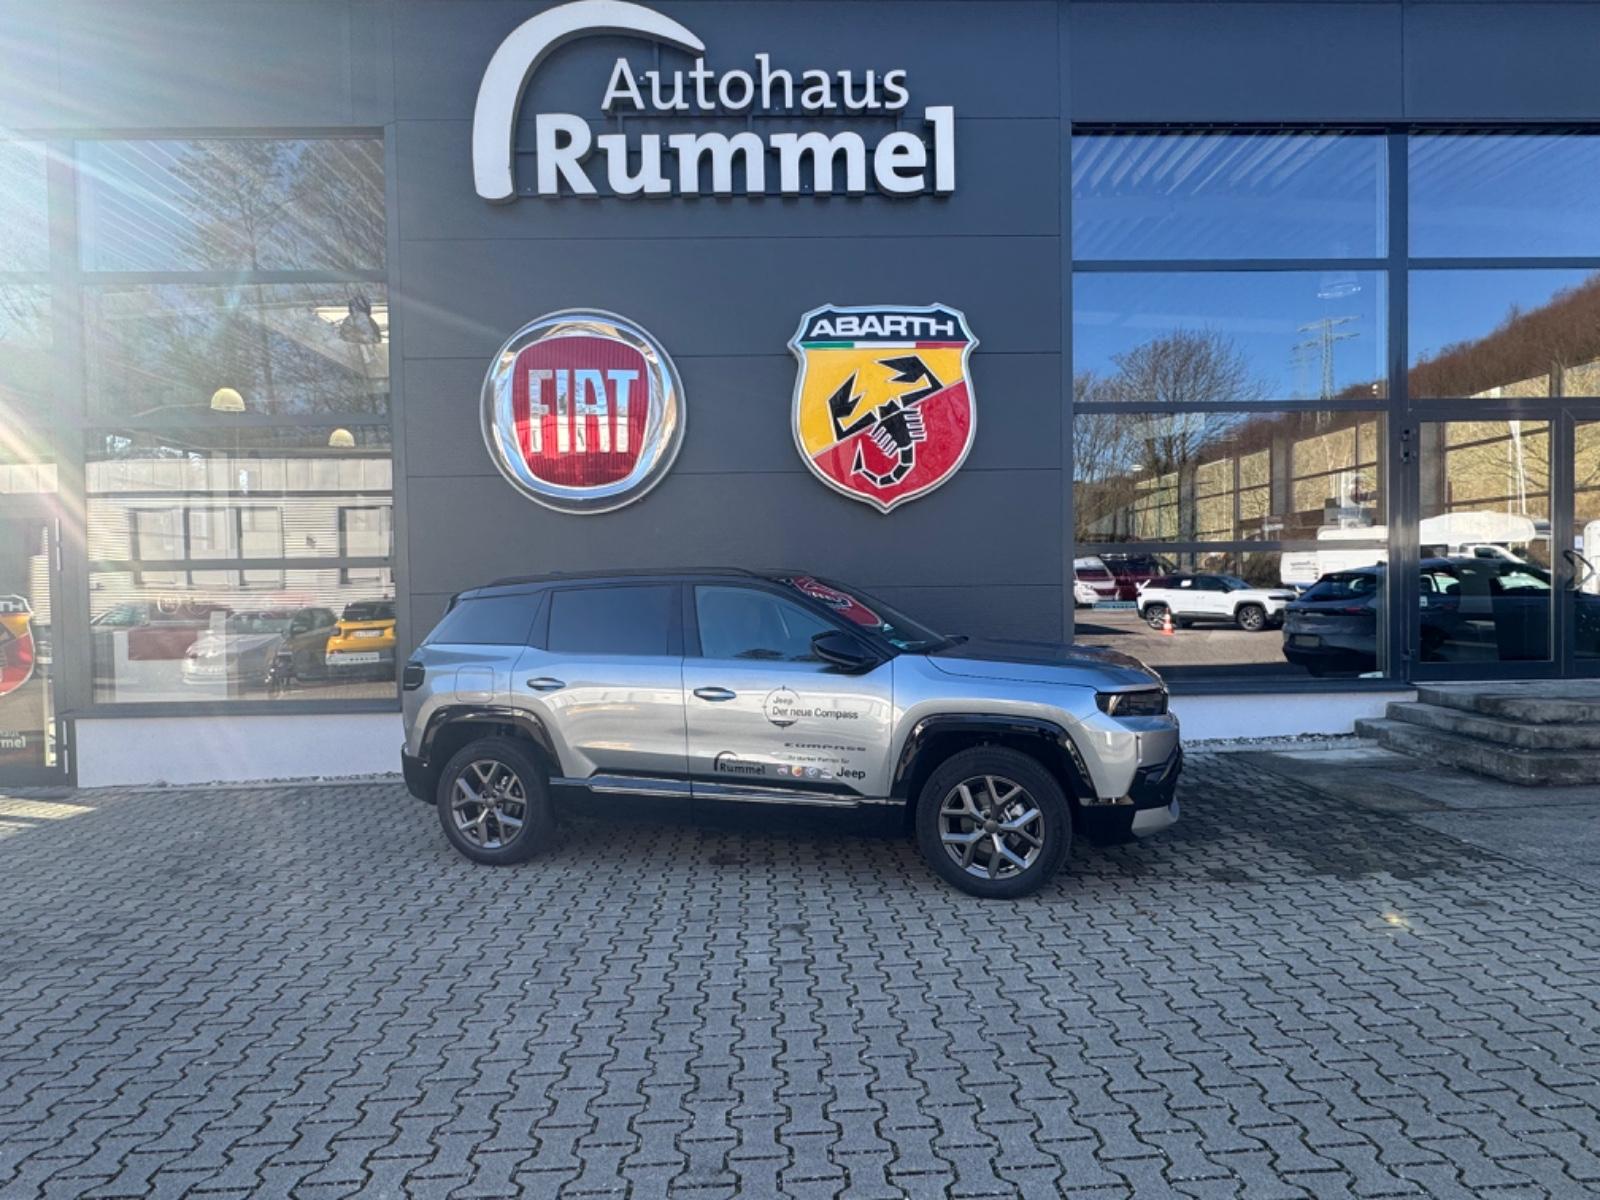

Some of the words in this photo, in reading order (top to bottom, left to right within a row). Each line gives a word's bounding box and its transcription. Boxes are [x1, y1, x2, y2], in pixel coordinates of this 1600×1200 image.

[601, 53, 910, 110] Autohaus
[535, 105, 955, 195] Rummel
[810, 316, 955, 337] ABARTH
[528, 369, 639, 454] FIAT
[772, 696, 794, 705] Jeep
[772, 706, 788, 716] Der
[790, 708, 812, 717] neue
[814, 708, 859, 720] Compass
[720, 762, 766, 776] Rummel
[836, 767, 866, 780] Jeep
